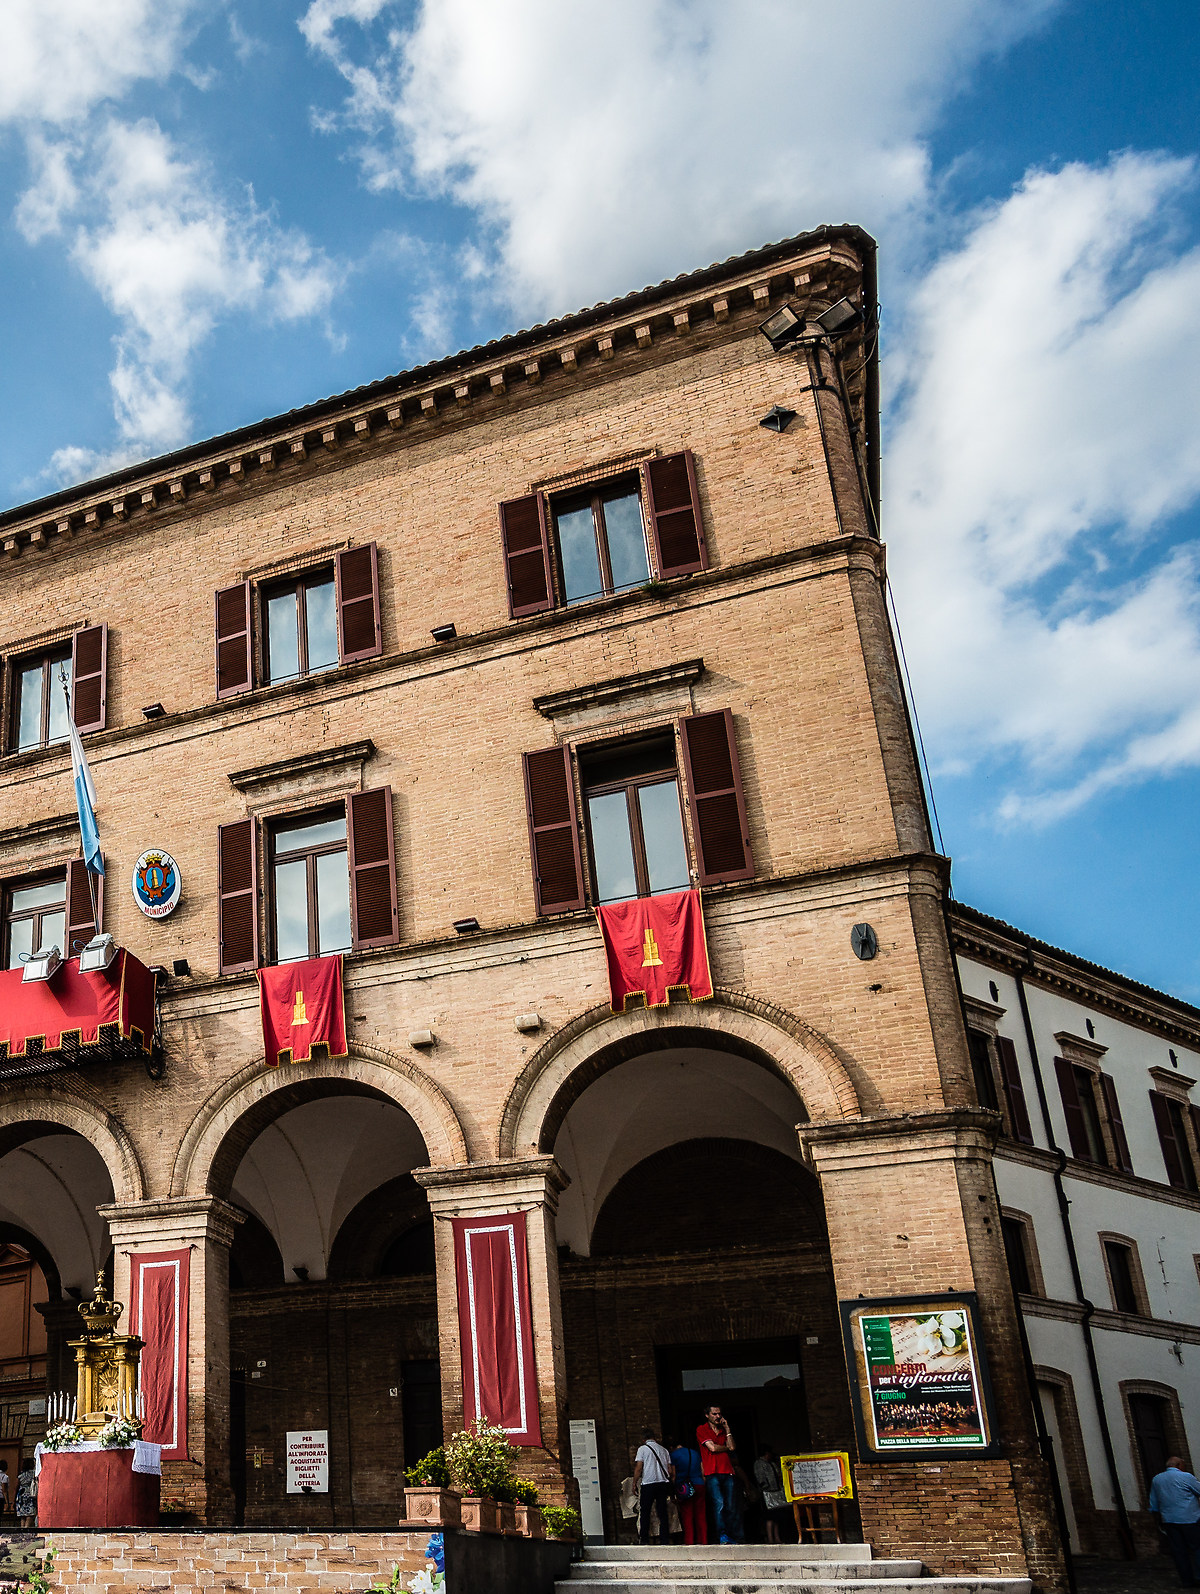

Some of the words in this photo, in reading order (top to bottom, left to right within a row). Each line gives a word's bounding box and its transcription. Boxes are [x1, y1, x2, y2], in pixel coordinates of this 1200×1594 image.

[144, 902, 174, 916] MUNICIPIO
[872, 1363, 926, 1375] CONCERTO
[879, 1376, 890, 1385] per
[899, 1371, 970, 1388] infiorata
[881, 1392, 906, 1400] GIUGNO
